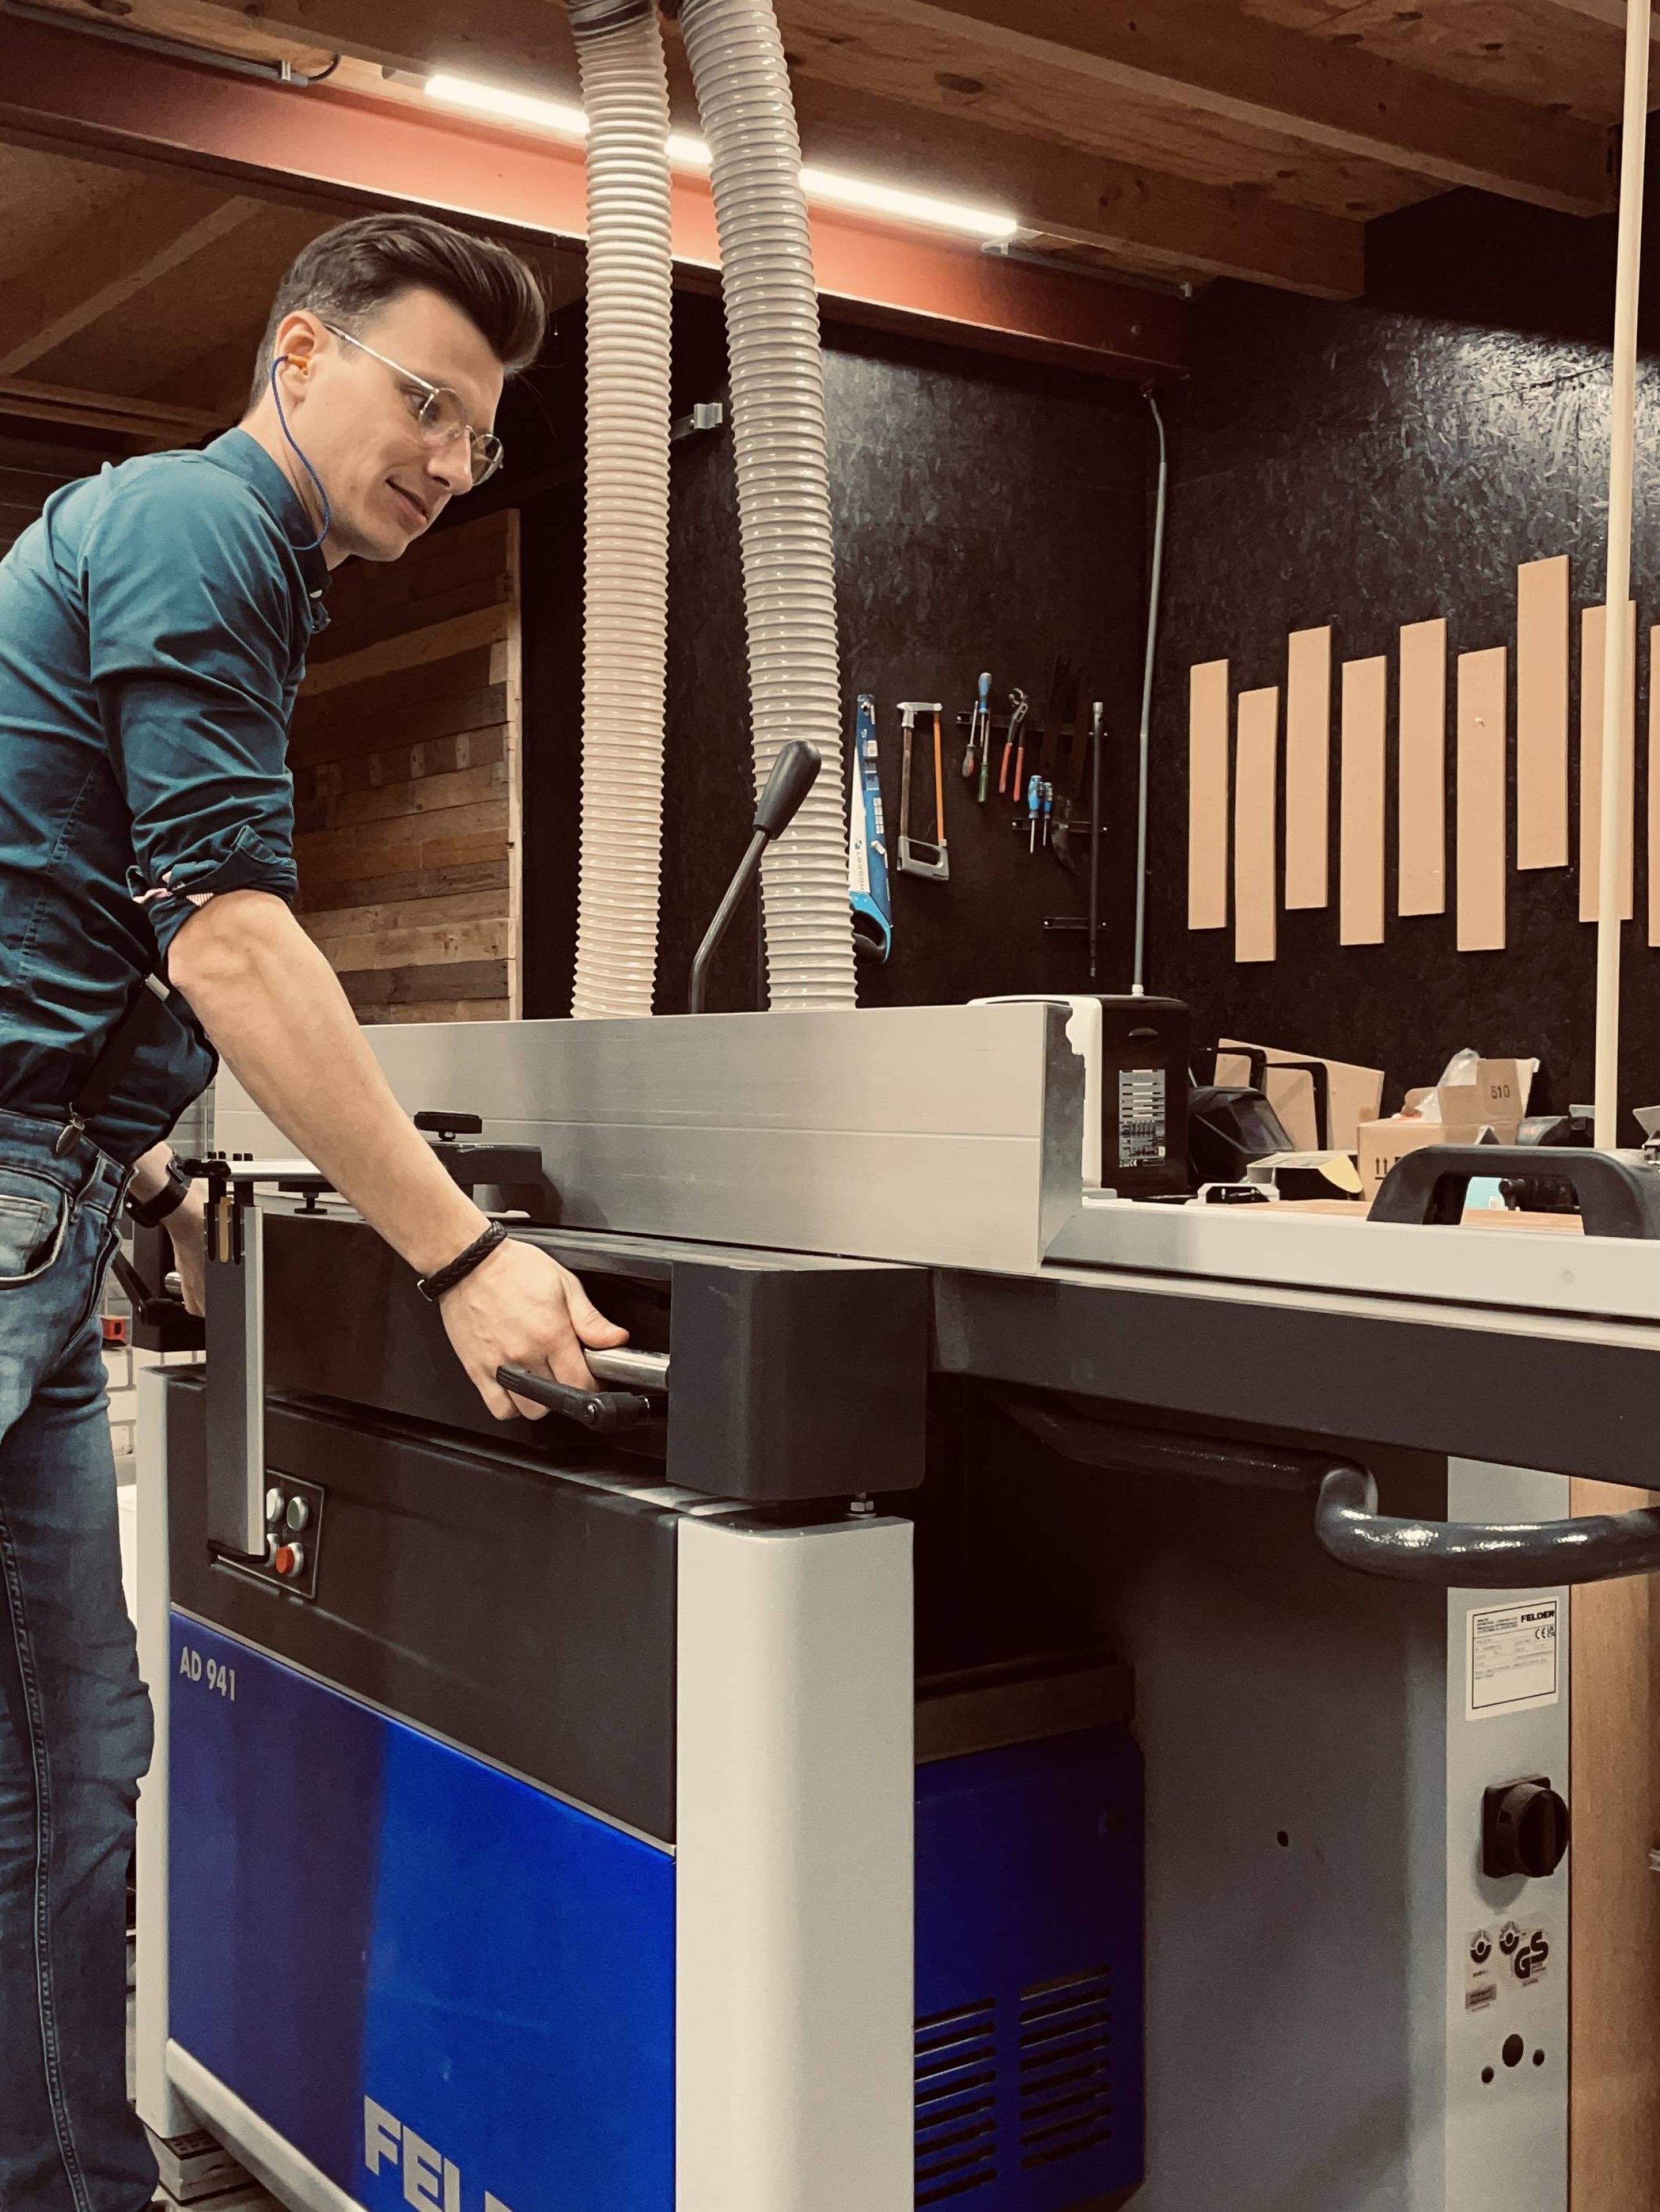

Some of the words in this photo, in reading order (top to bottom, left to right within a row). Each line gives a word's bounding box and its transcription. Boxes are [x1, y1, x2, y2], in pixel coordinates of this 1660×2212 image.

[1490, 1085, 1510, 1100] 510
[1521, 1610, 1554, 1623] FELDER
[180, 1646, 202, 1681] AD
[207, 1658, 235, 1701] 941
[1514, 1931, 1548, 1979] GS
